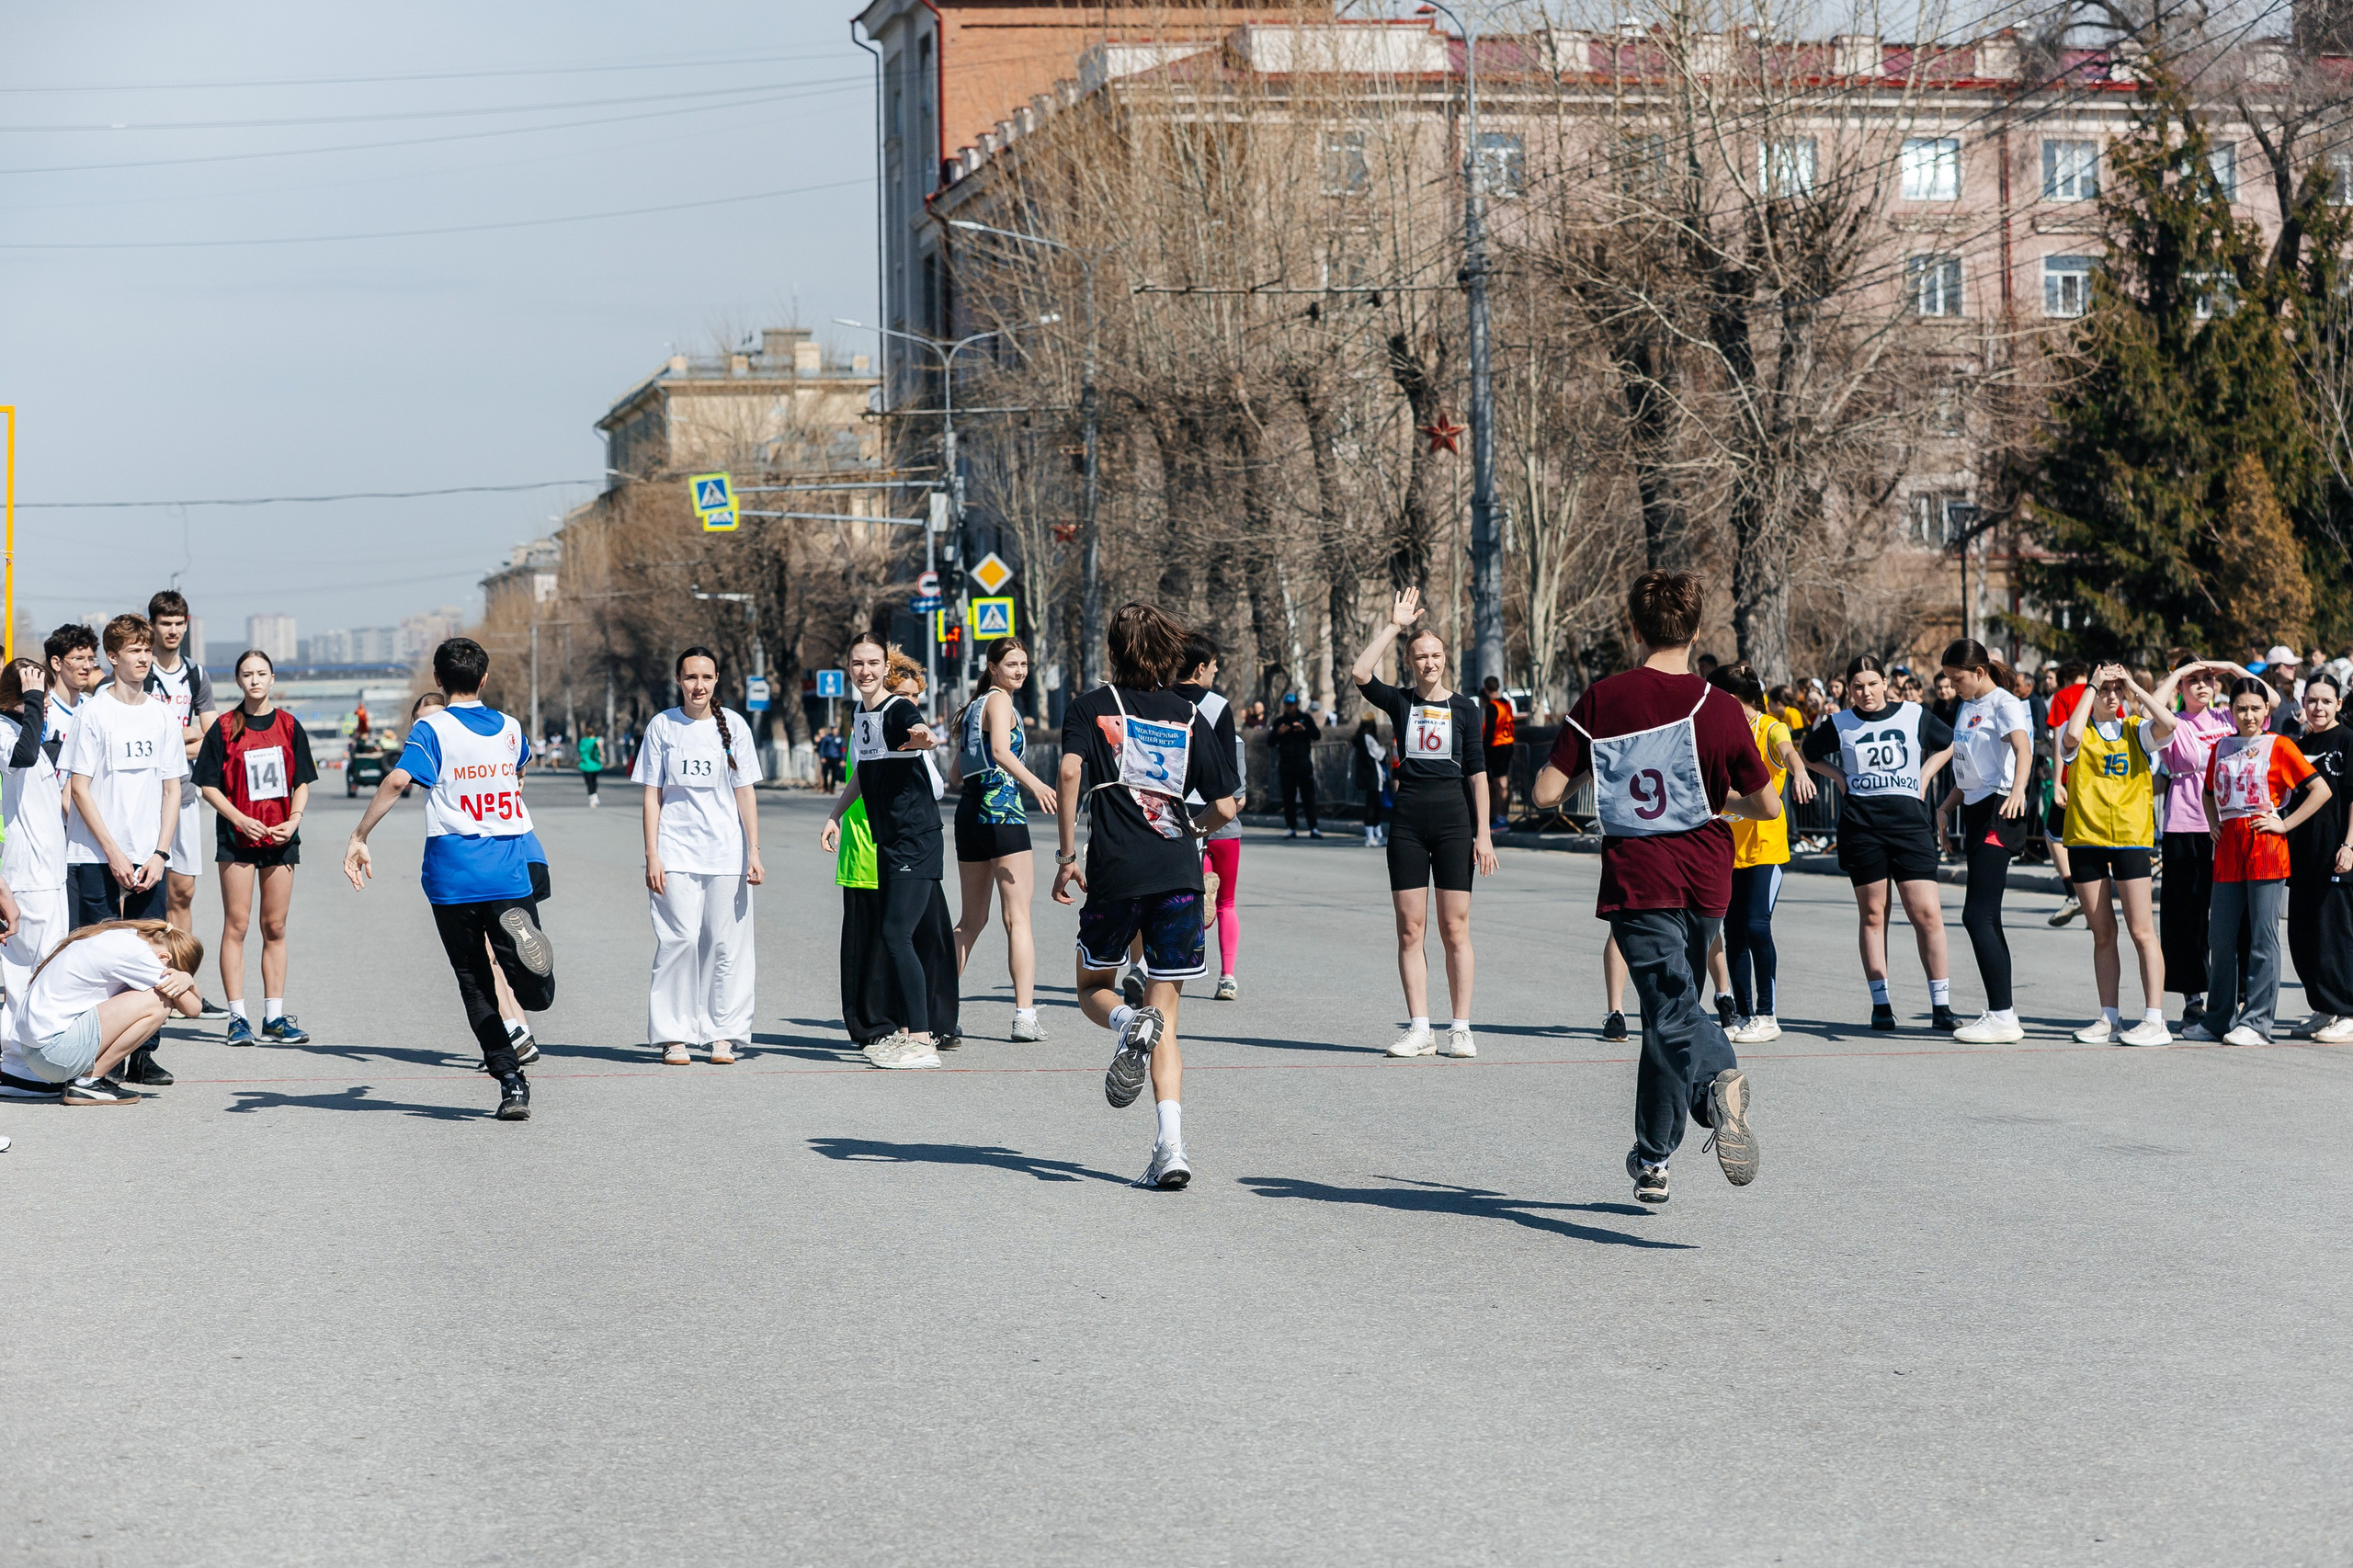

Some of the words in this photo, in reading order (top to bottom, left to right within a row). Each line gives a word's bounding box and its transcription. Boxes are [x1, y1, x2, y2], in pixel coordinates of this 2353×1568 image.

[861, 720, 870, 744] 3
[1416, 725, 1443, 752] 16
[125, 740, 153, 757] 133
[1867, 745, 1894, 767] 20
[453, 763, 497, 780] МБОУ
[681, 759, 711, 776] 133
[1145, 751, 1169, 780] 3
[2103, 753, 2129, 776] 15
[250, 763, 278, 790] 14
[1629, 767, 1667, 820] 9
